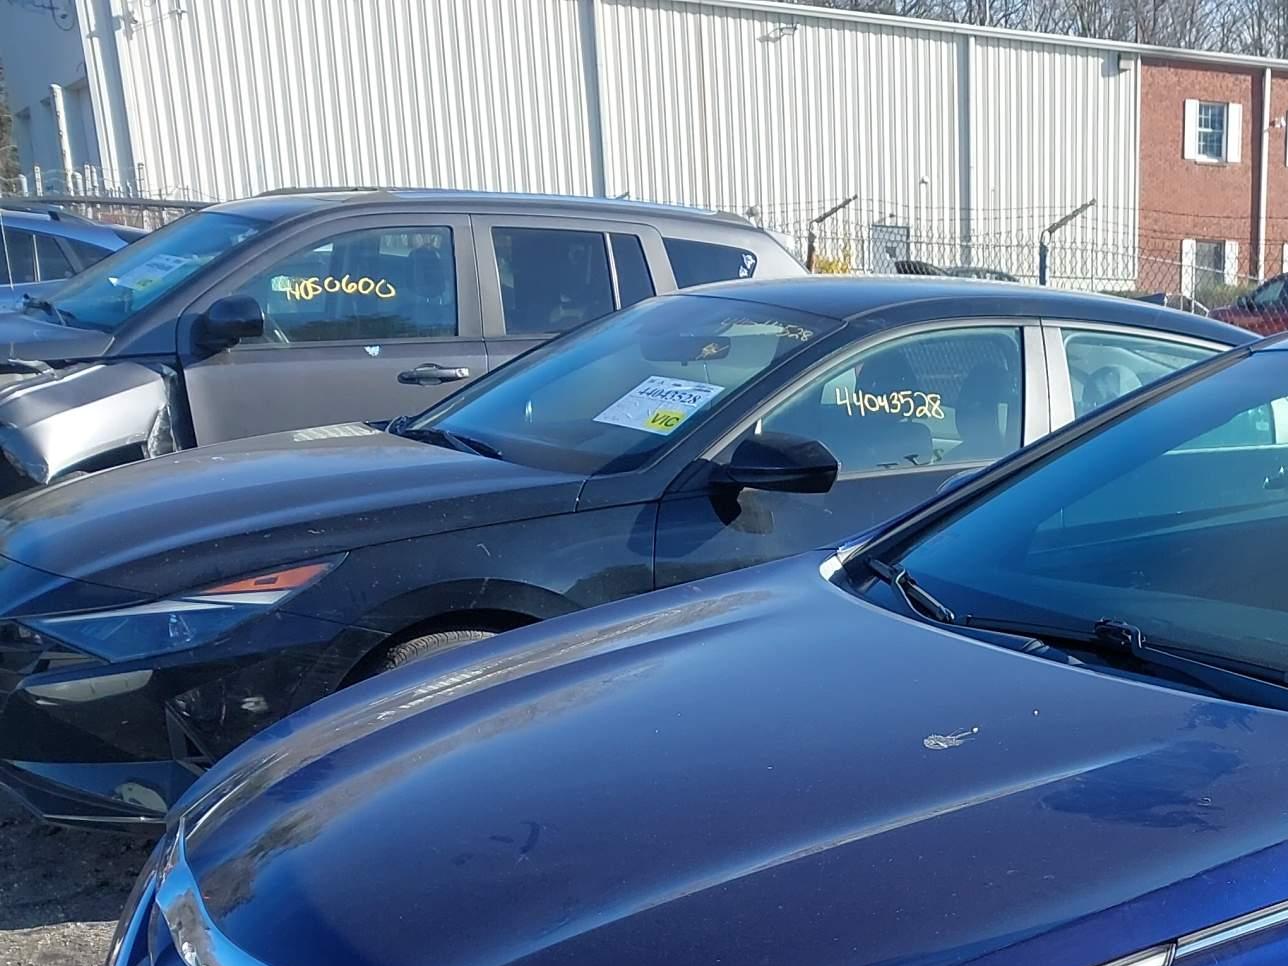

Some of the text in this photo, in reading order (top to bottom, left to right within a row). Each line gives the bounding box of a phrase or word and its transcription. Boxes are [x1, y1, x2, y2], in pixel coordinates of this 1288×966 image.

[637, 387, 702, 404] 44043528
[835, 386, 945, 419] 44043528
[650, 413, 680, 428] VIC
